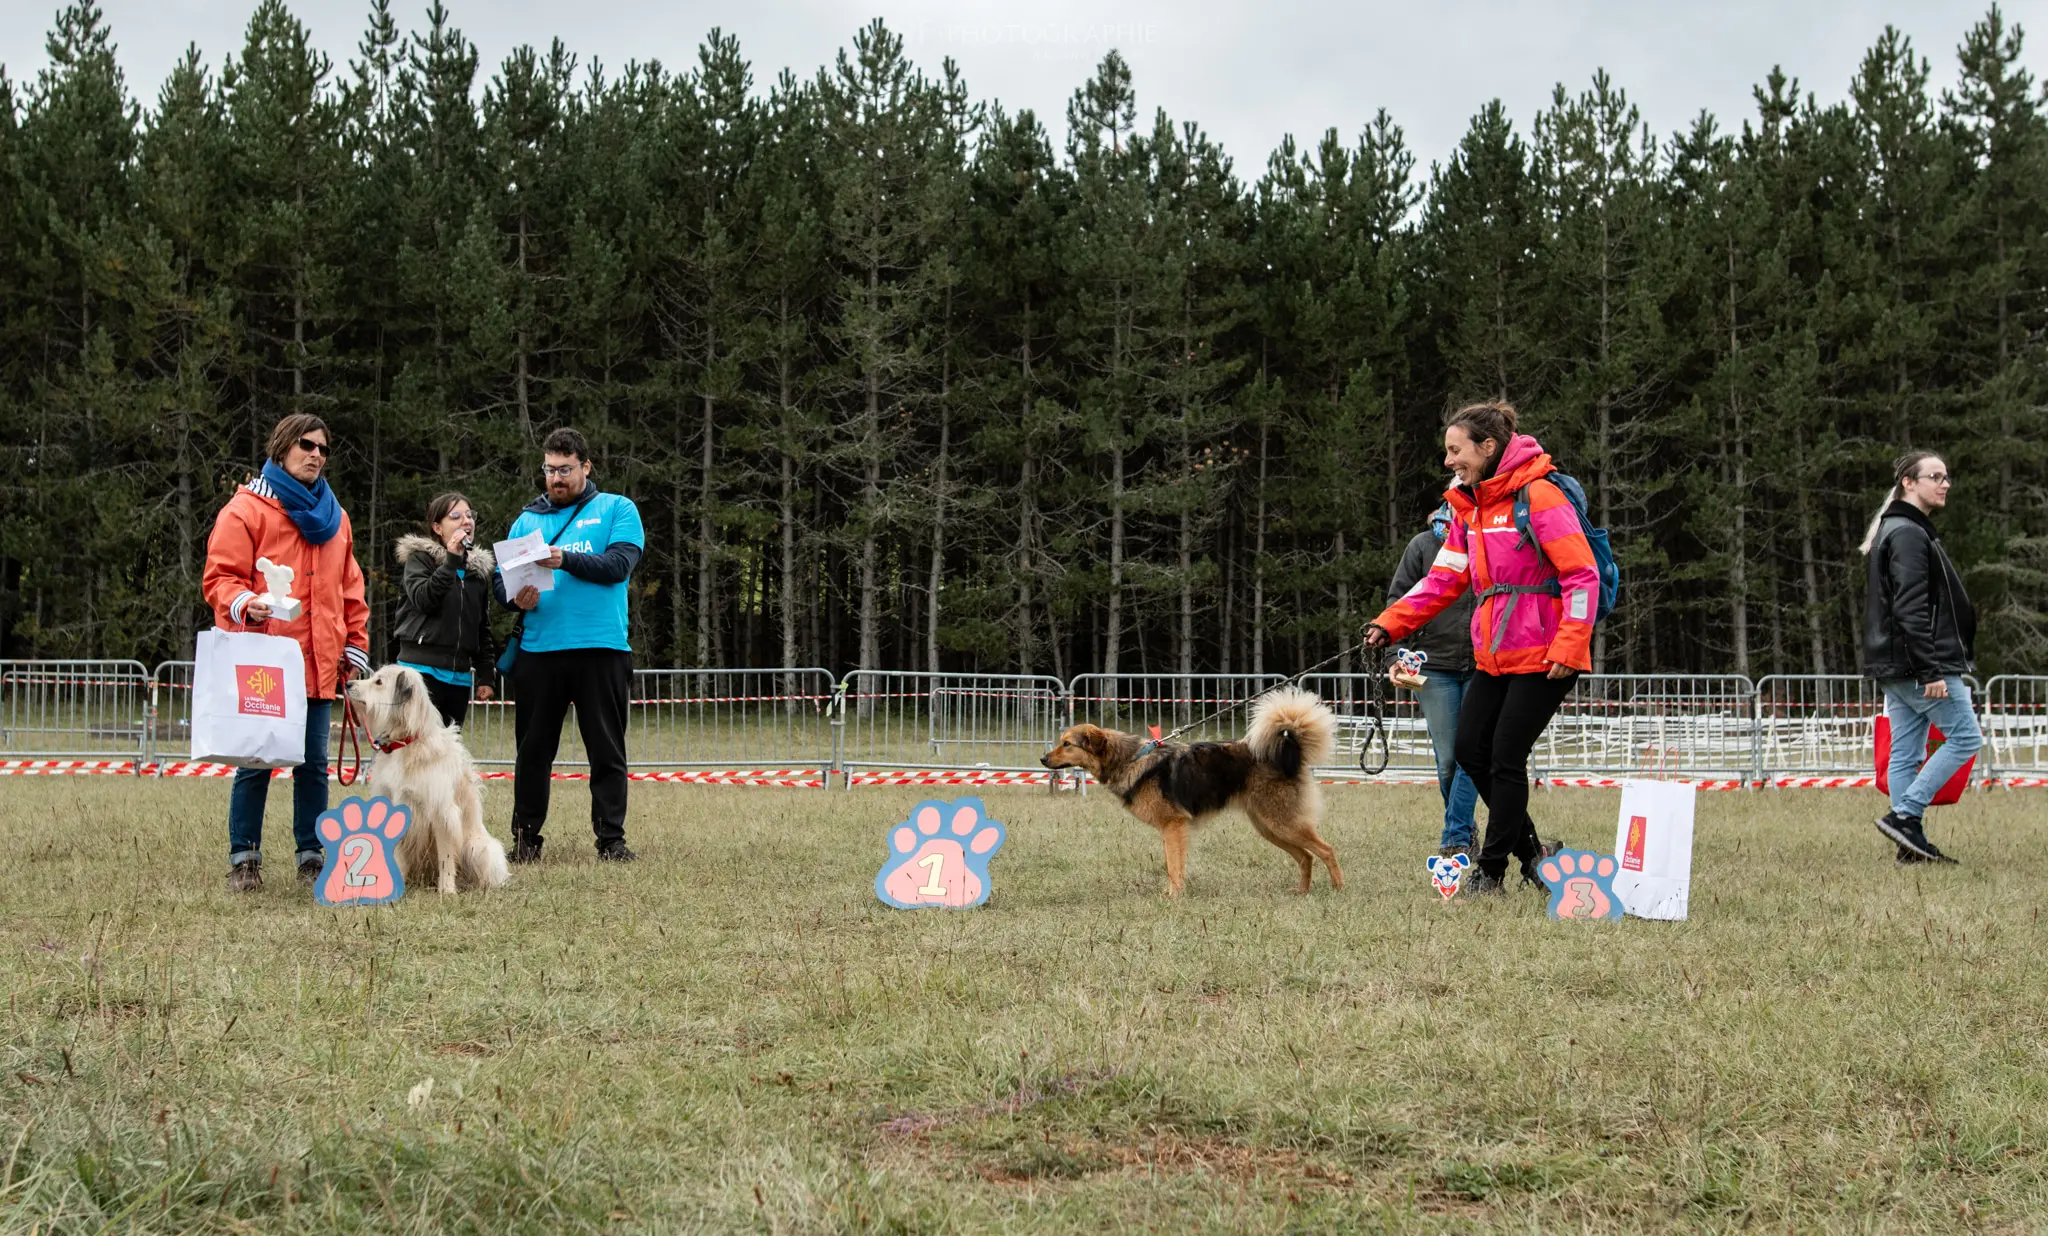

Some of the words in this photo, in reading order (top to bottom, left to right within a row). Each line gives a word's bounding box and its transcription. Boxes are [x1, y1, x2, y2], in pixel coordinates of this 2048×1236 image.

[244, 700, 281, 711] Occitanie
[344, 837, 378, 887] 2
[917, 852, 947, 896] 1
[1570, 882, 1596, 916] 3
